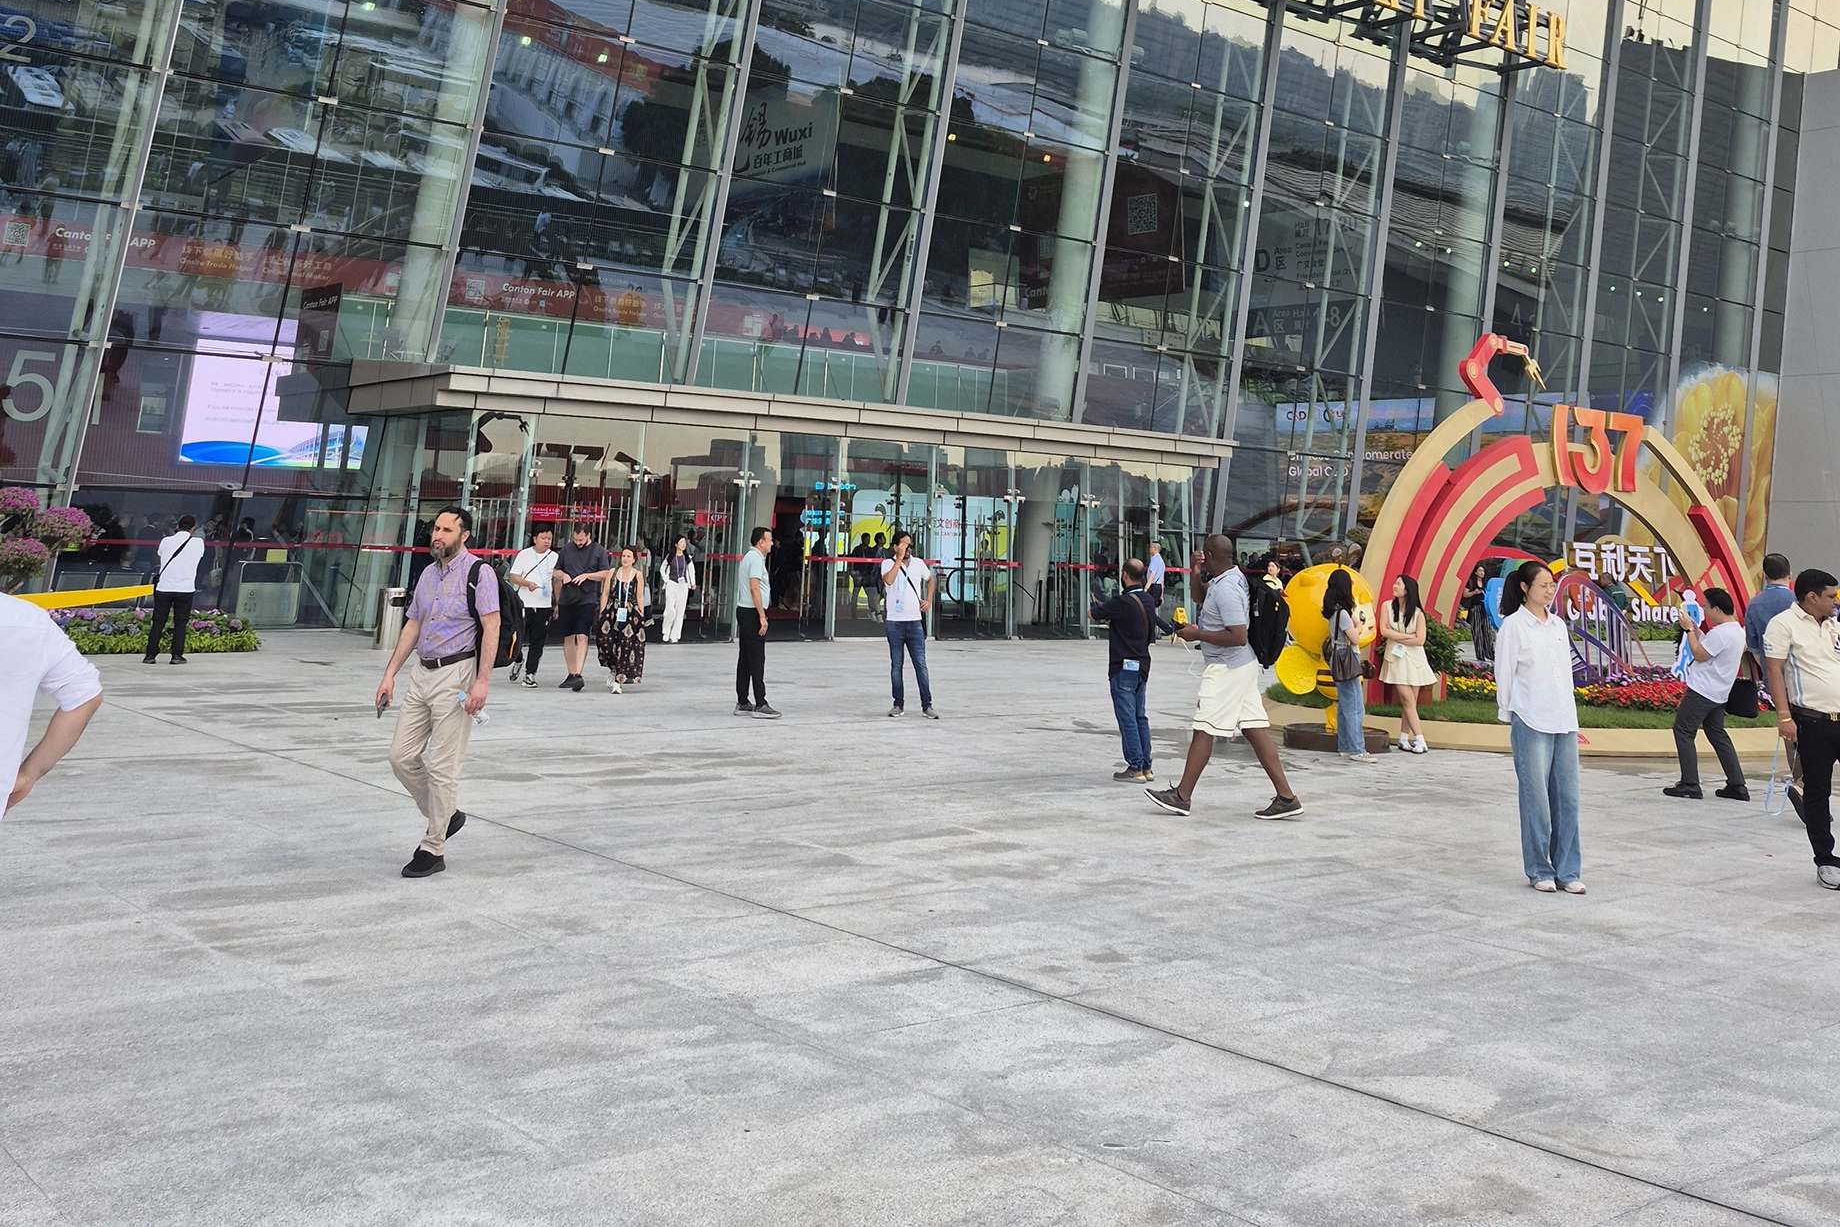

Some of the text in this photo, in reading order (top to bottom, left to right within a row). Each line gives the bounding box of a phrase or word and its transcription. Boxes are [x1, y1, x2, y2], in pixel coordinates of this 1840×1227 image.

[774, 121, 813, 146] Wuxi
[753, 143, 804, 170] 百年工商城
[130, 237, 156, 249] APP
[206, 260, 228, 269] Trade
[229, 263, 254, 273] Helper
[1254, 246, 1292, 272] D Area
[1275, 256, 1287, 271] 区
[302, 300, 318, 310] Canton
[327, 295, 339, 306] APP
[502, 282, 576, 299] Canton Fair APP
[1252, 310, 1270, 335] A
[1272, 309, 1290, 318] Area
[1273, 318, 1286, 333] 区
[1551, 403, 1644, 495] 137
[1573, 541, 1676, 584] 互利天下
[1631, 597, 1679, 623] Share
